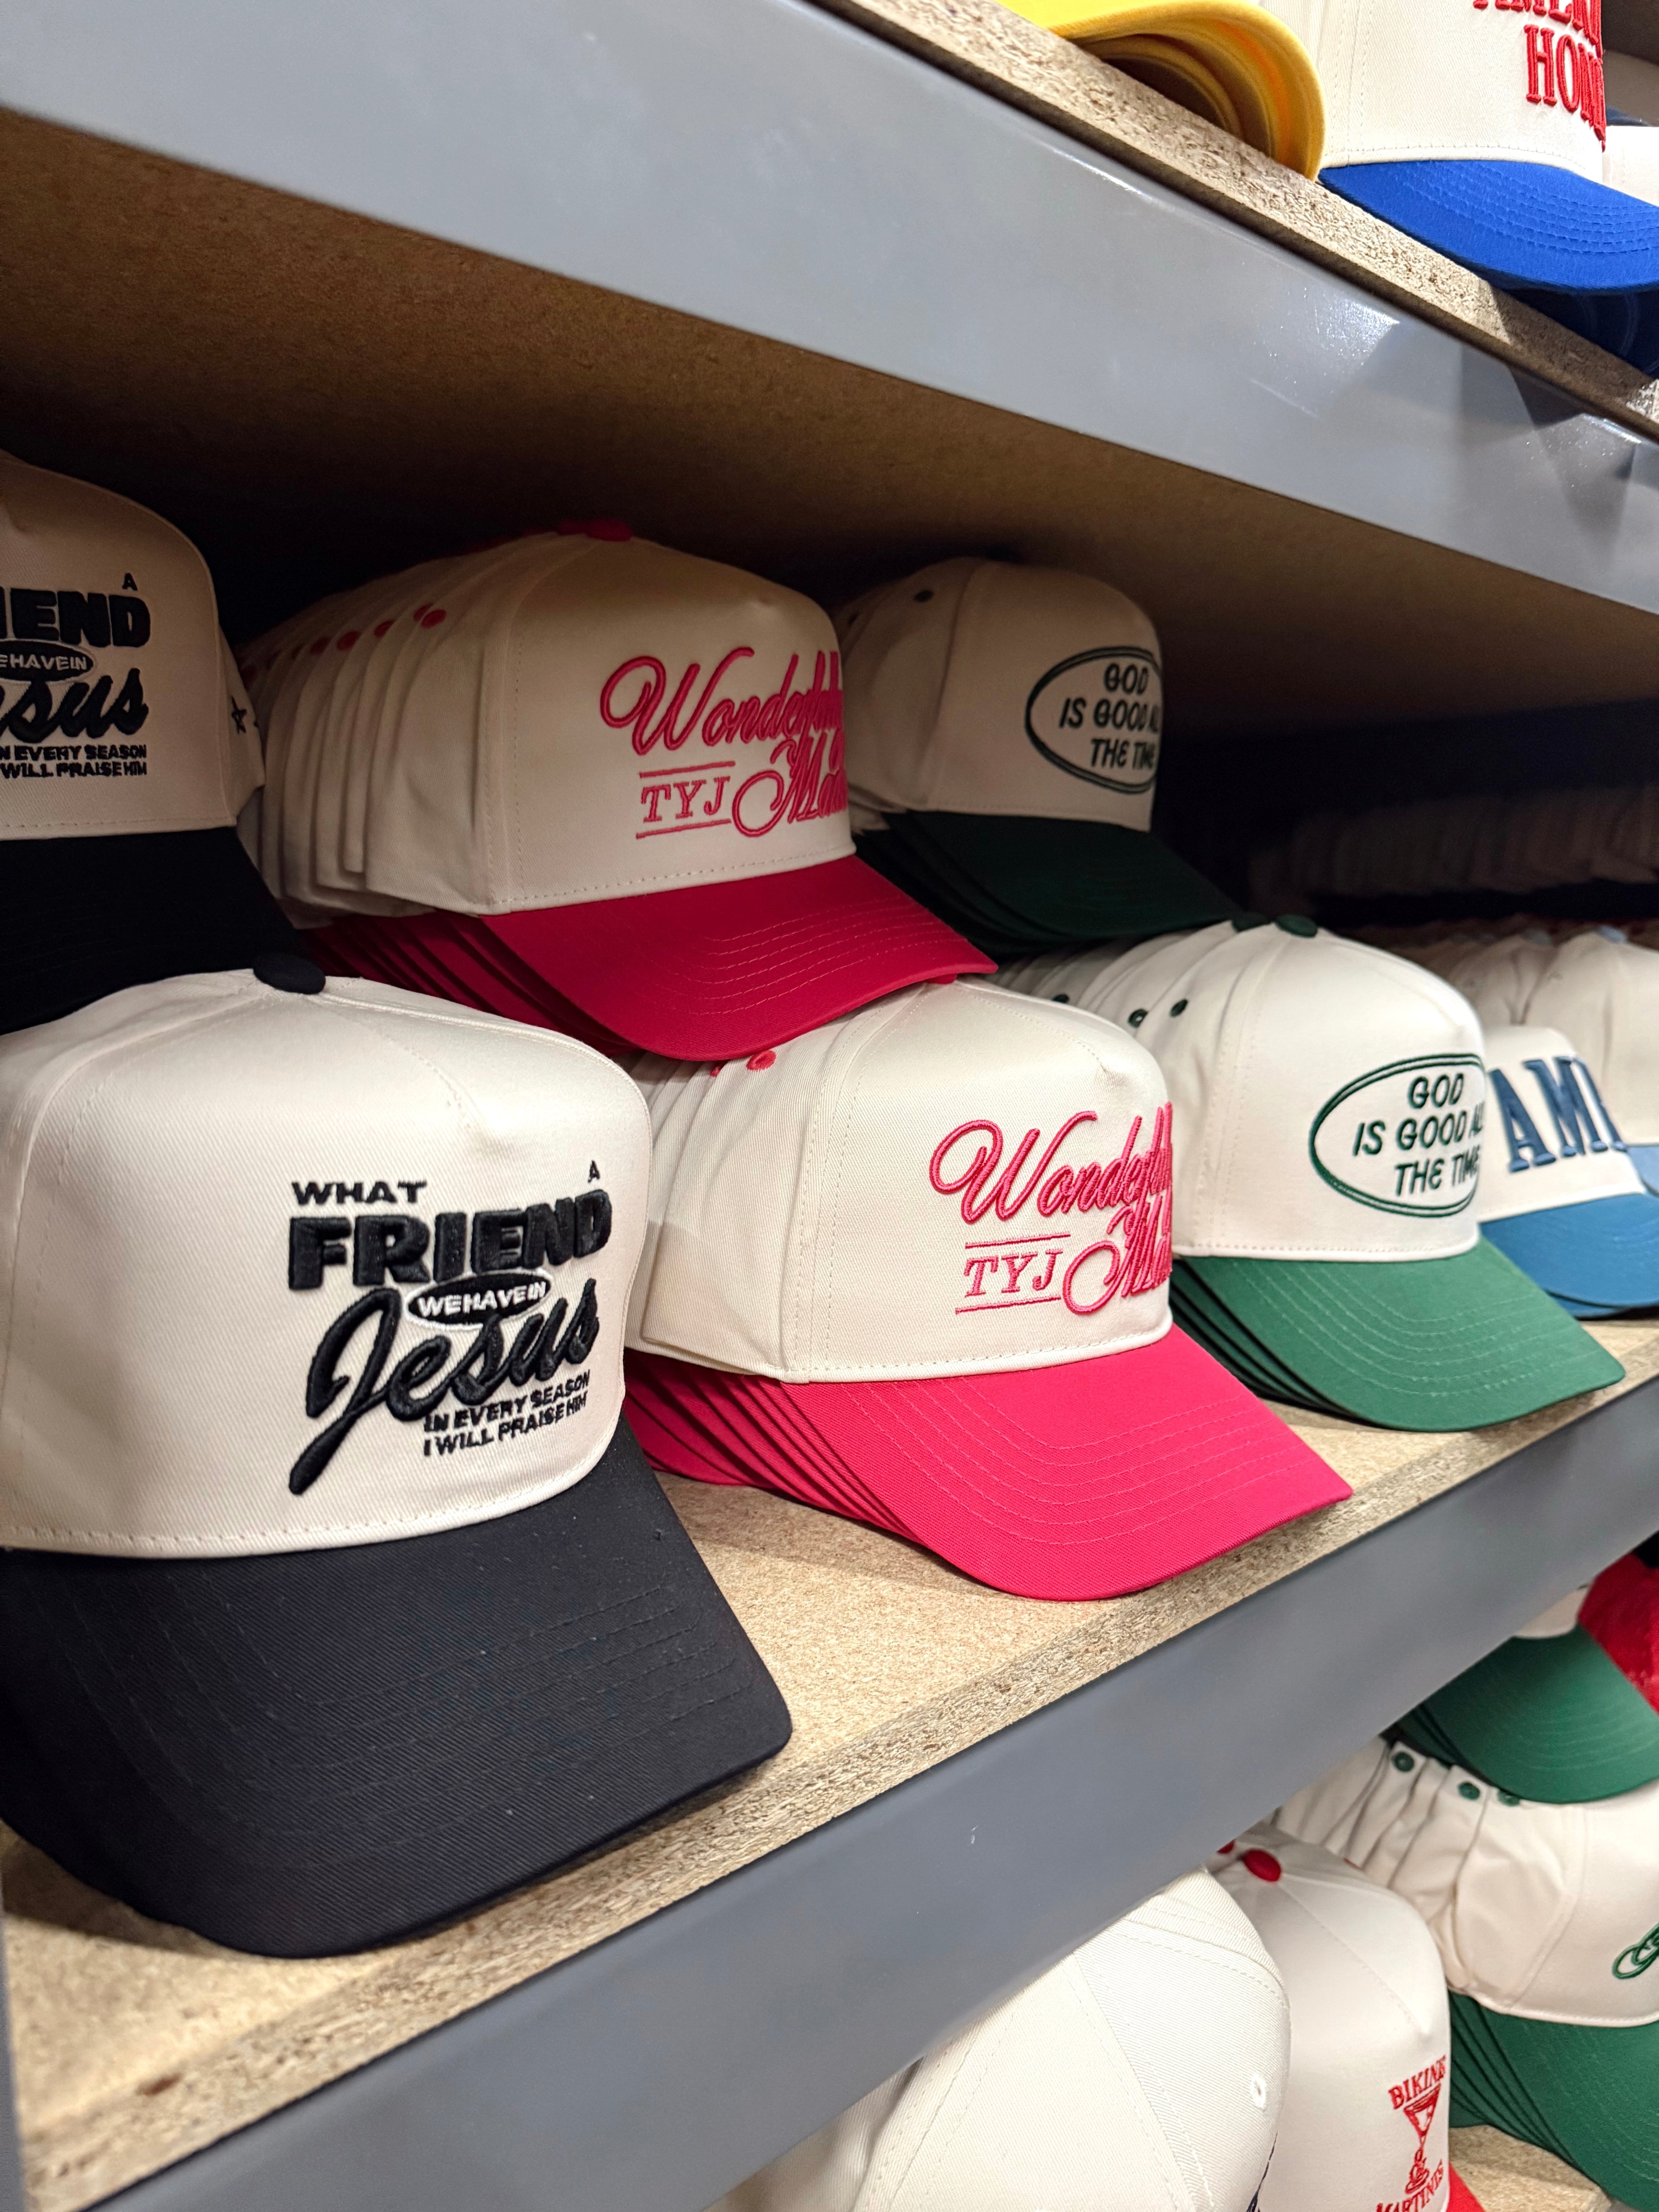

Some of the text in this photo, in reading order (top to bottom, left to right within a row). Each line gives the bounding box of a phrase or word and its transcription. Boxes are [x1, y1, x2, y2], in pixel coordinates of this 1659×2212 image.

[122, 573, 138, 591] A
[0, 586, 151, 647] END
[1104, 663, 1149, 695] GOD
[1059, 698, 1086, 729] IS
[1093, 699, 1147, 732] GOOD
[14, 745, 82, 761] EVERY
[84, 744, 147, 760] SEASON
[56, 762, 122, 777] PRAISE
[123, 761, 147, 776] HIM
[1091, 738, 1129, 769] THE
[641, 776, 730, 823] TYJ
[1407, 1073, 1464, 1109] GOD
[1352, 1120, 1386, 1157] IS
[1396, 1110, 1467, 1151] GOOD
[292, 1160, 600, 1205] WHAT A
[1395, 1158, 1445, 1197] THE
[288, 1189, 612, 1290] FRIEND
[964, 1249, 1063, 1298] TYJ
[289, 1278, 600, 1495] Jesus
[424, 1369, 590, 1432] IN EVERY SEASON
[424, 1390, 588, 1456] I WILL PRAISE HIM
